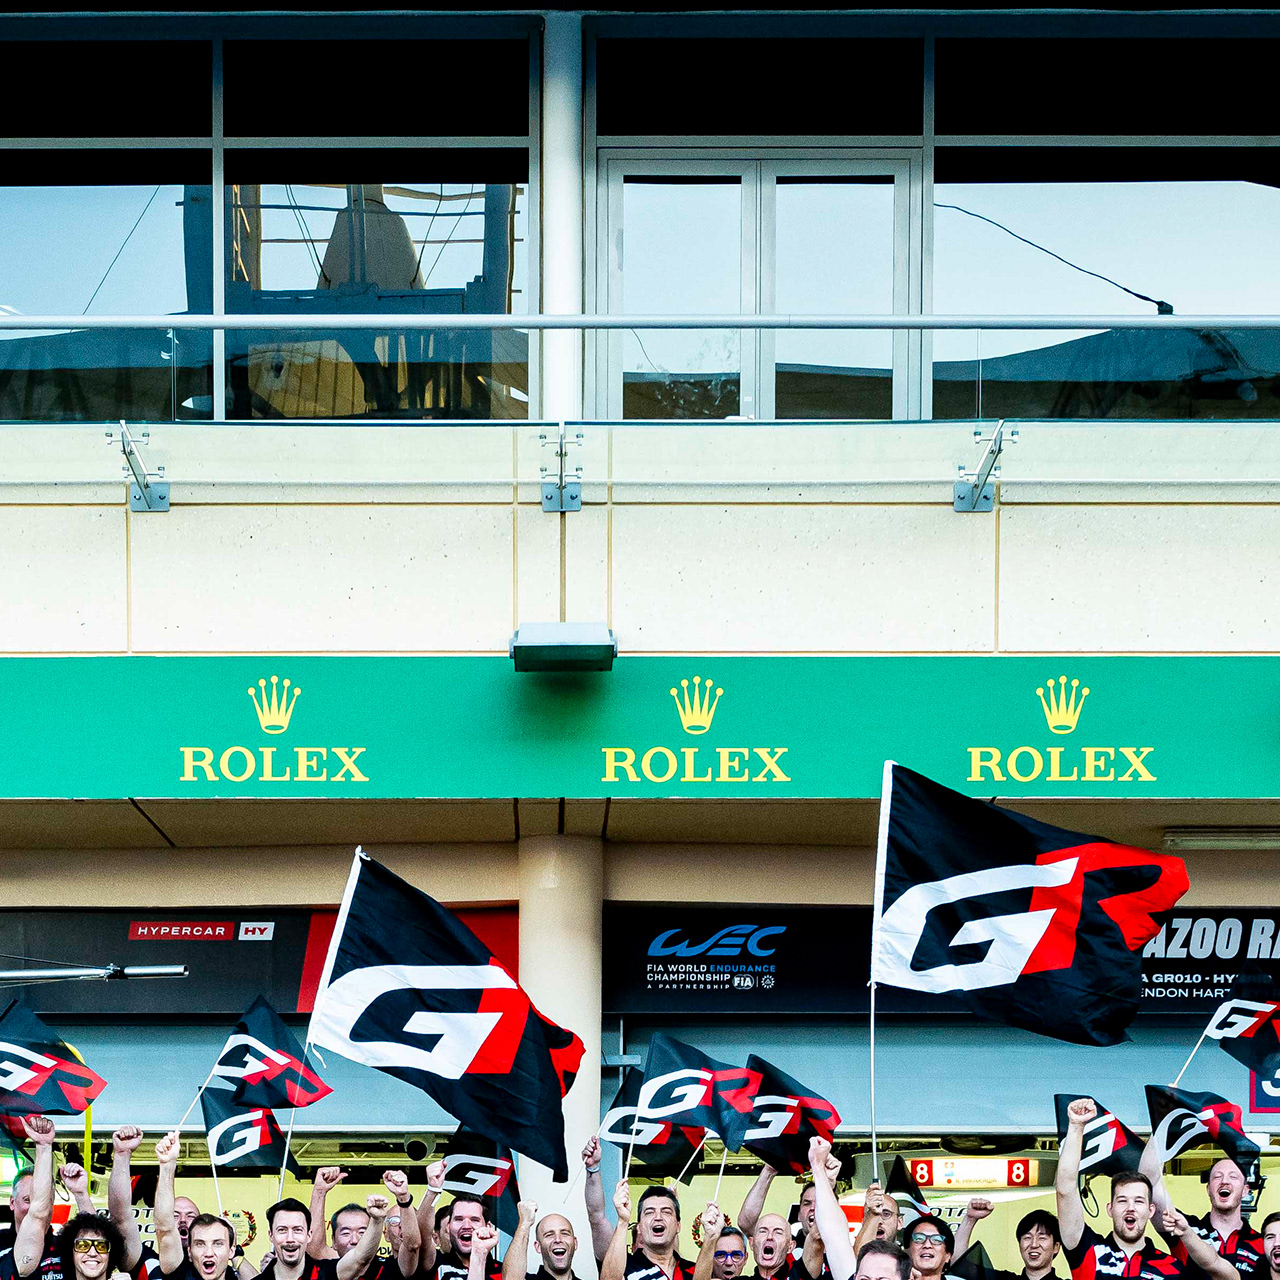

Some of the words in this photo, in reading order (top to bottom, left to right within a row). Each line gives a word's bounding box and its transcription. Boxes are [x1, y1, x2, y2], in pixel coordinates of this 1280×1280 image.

[182, 747, 364, 782] ROLEX
[603, 747, 787, 783] ROLEX
[969, 747, 1153, 782] ROLEX
[137, 925, 226, 937] HYPERCAR
[243, 925, 269, 937] HY
[648, 924, 787, 957] WEC
[647, 973, 731, 981] CHAMPIONSHIP
[734, 976, 753, 987] FIA
[1152, 973, 1202, 983] GR010
[915, 1163, 929, 1183] 8
[1012, 1162, 1025, 1183] 8
